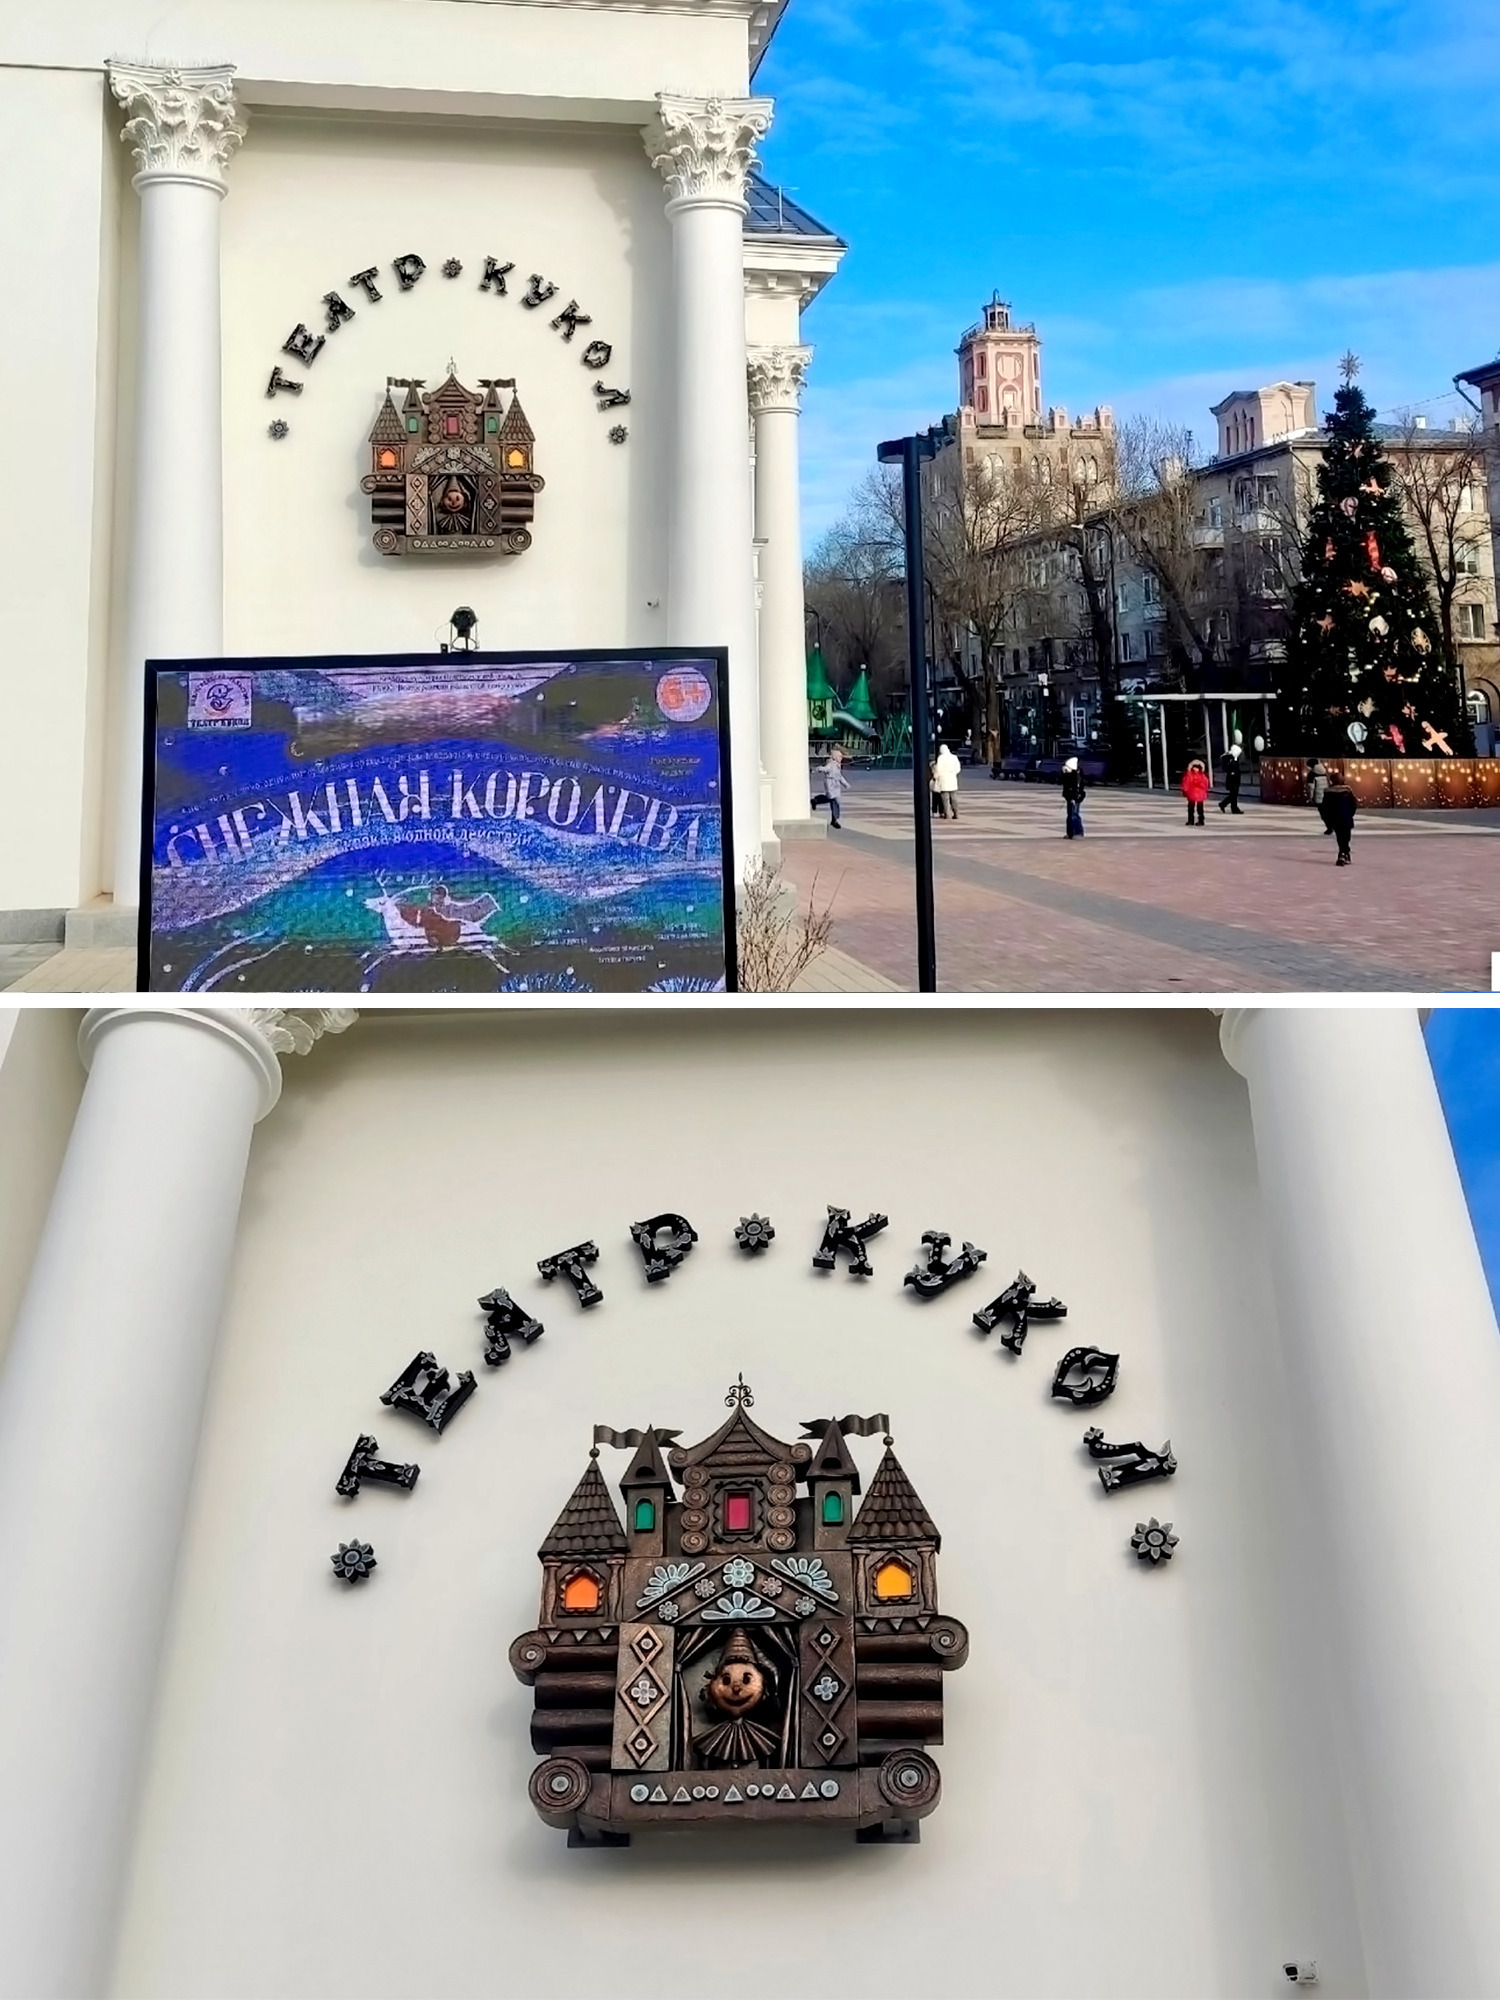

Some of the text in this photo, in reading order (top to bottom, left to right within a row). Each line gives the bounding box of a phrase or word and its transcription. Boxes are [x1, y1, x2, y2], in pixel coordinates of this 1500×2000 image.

[268, 254, 631, 412] ТЕАТР КУКОЛ
[661, 677, 706, 710] 6+
[167, 769, 431, 868] СНЕЖНАЯ
[450, 768, 700, 861] КОРОЛЕВА
[336, 1205, 1179, 1501] ТЕАТР КУКОЛ
